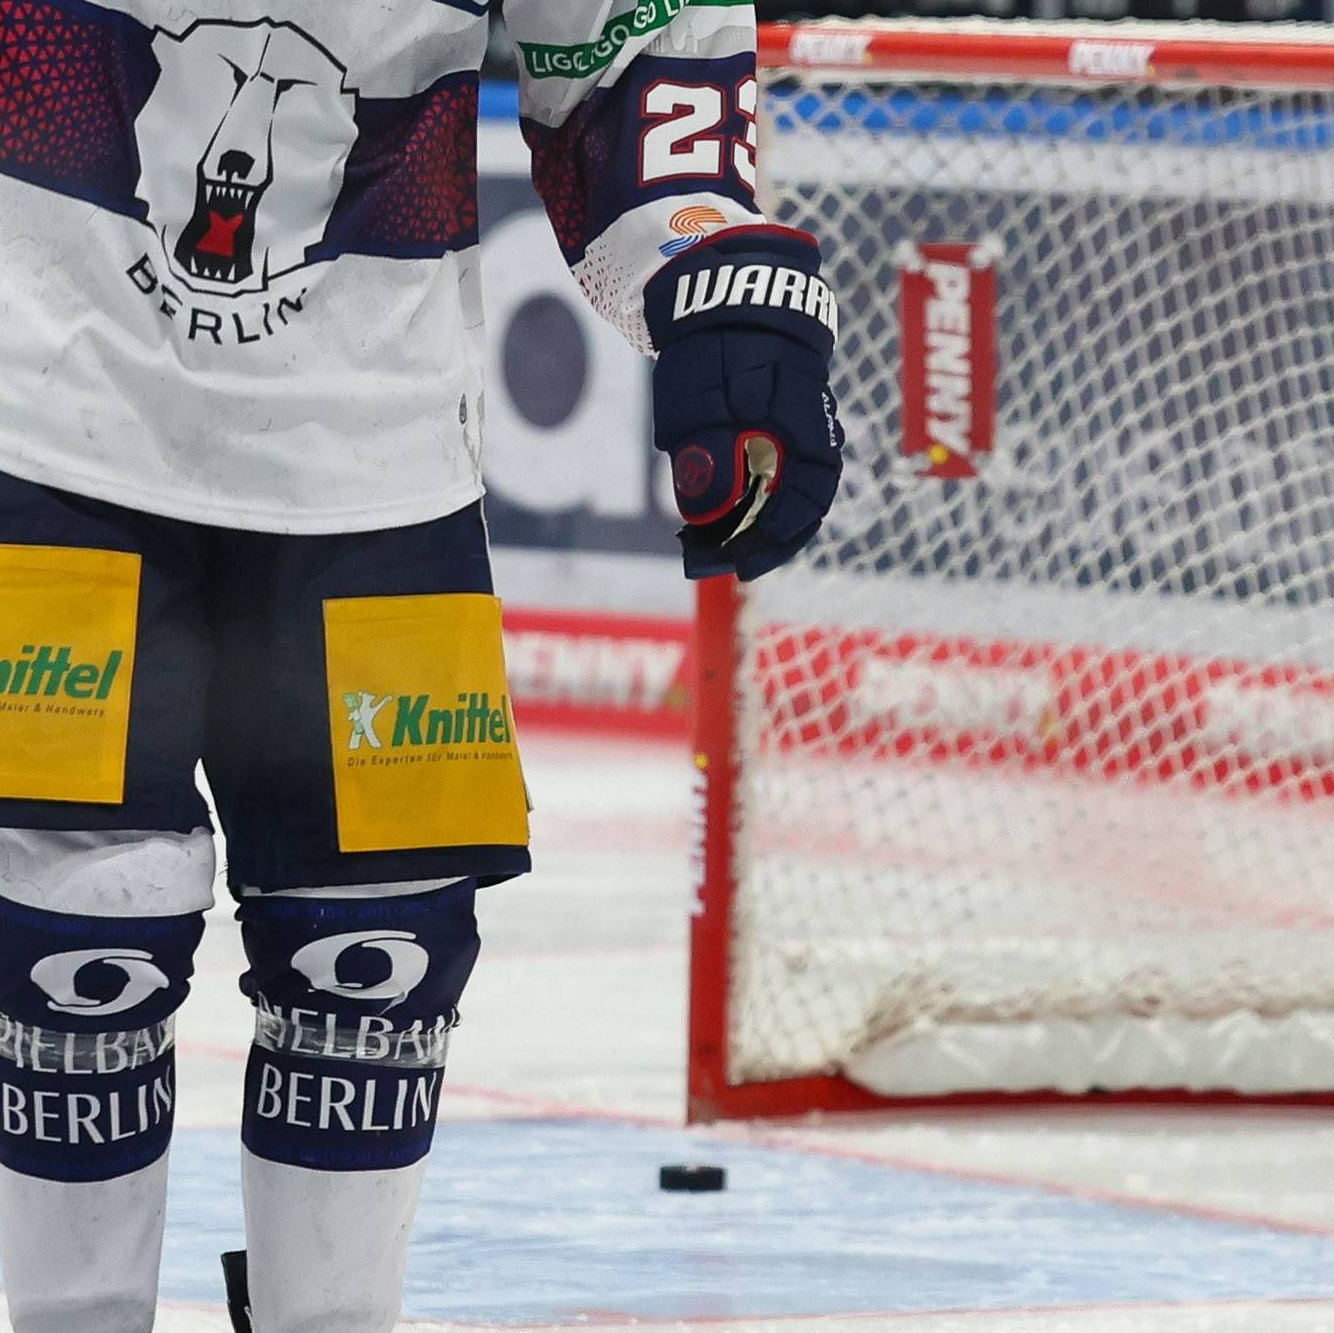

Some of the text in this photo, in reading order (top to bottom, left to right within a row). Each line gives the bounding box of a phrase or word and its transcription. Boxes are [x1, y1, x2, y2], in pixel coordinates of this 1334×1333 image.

[125, 252, 310, 346] BERLIN
[672, 264, 837, 330] WARRI
[391, 692, 511, 747] Knittel
[2, 1065, 173, 1145] BERLIN
[256, 1063, 438, 1132] BERLIN
